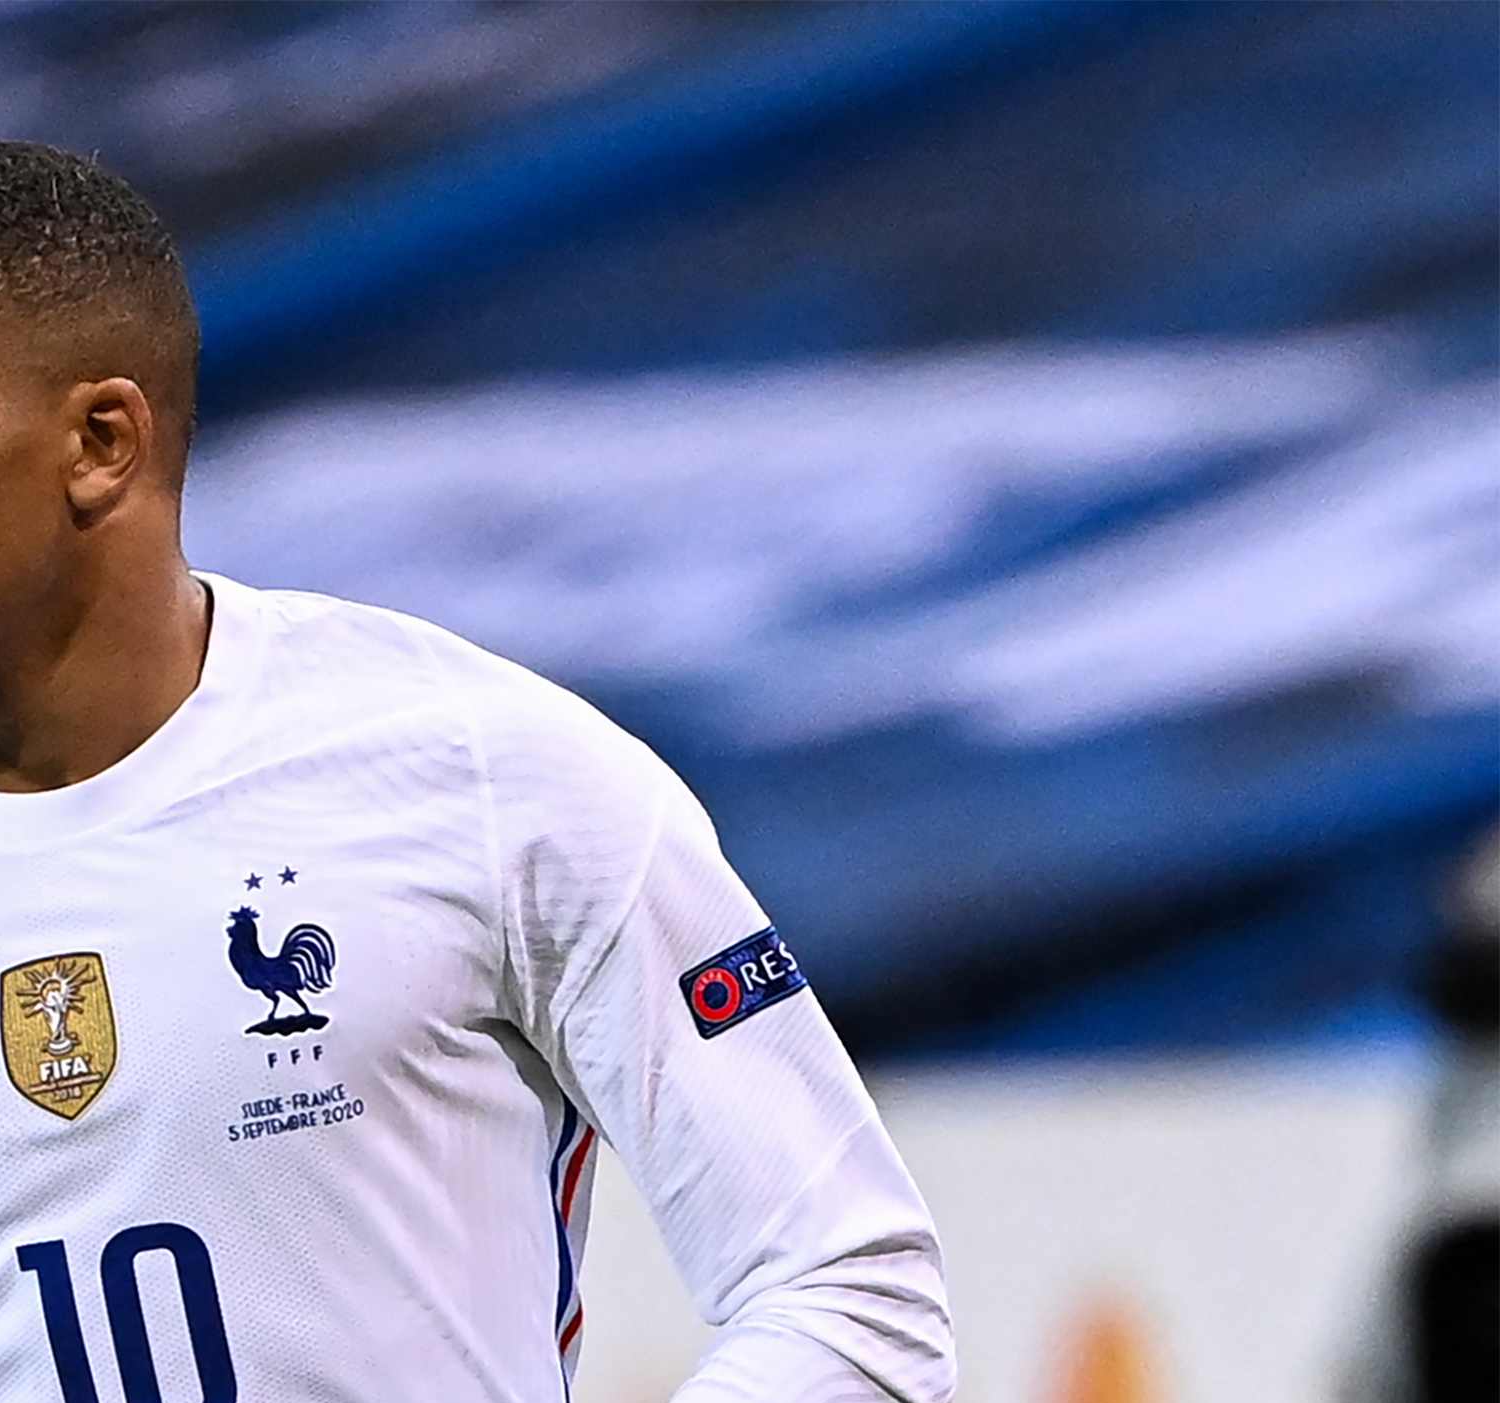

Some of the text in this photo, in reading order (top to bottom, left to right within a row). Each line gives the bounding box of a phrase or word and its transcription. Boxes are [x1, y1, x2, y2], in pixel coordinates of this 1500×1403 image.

[40, 1056, 89, 1082] FIFA
[228, 1098, 365, 1142] 5 SEPTEMBRE 2020
